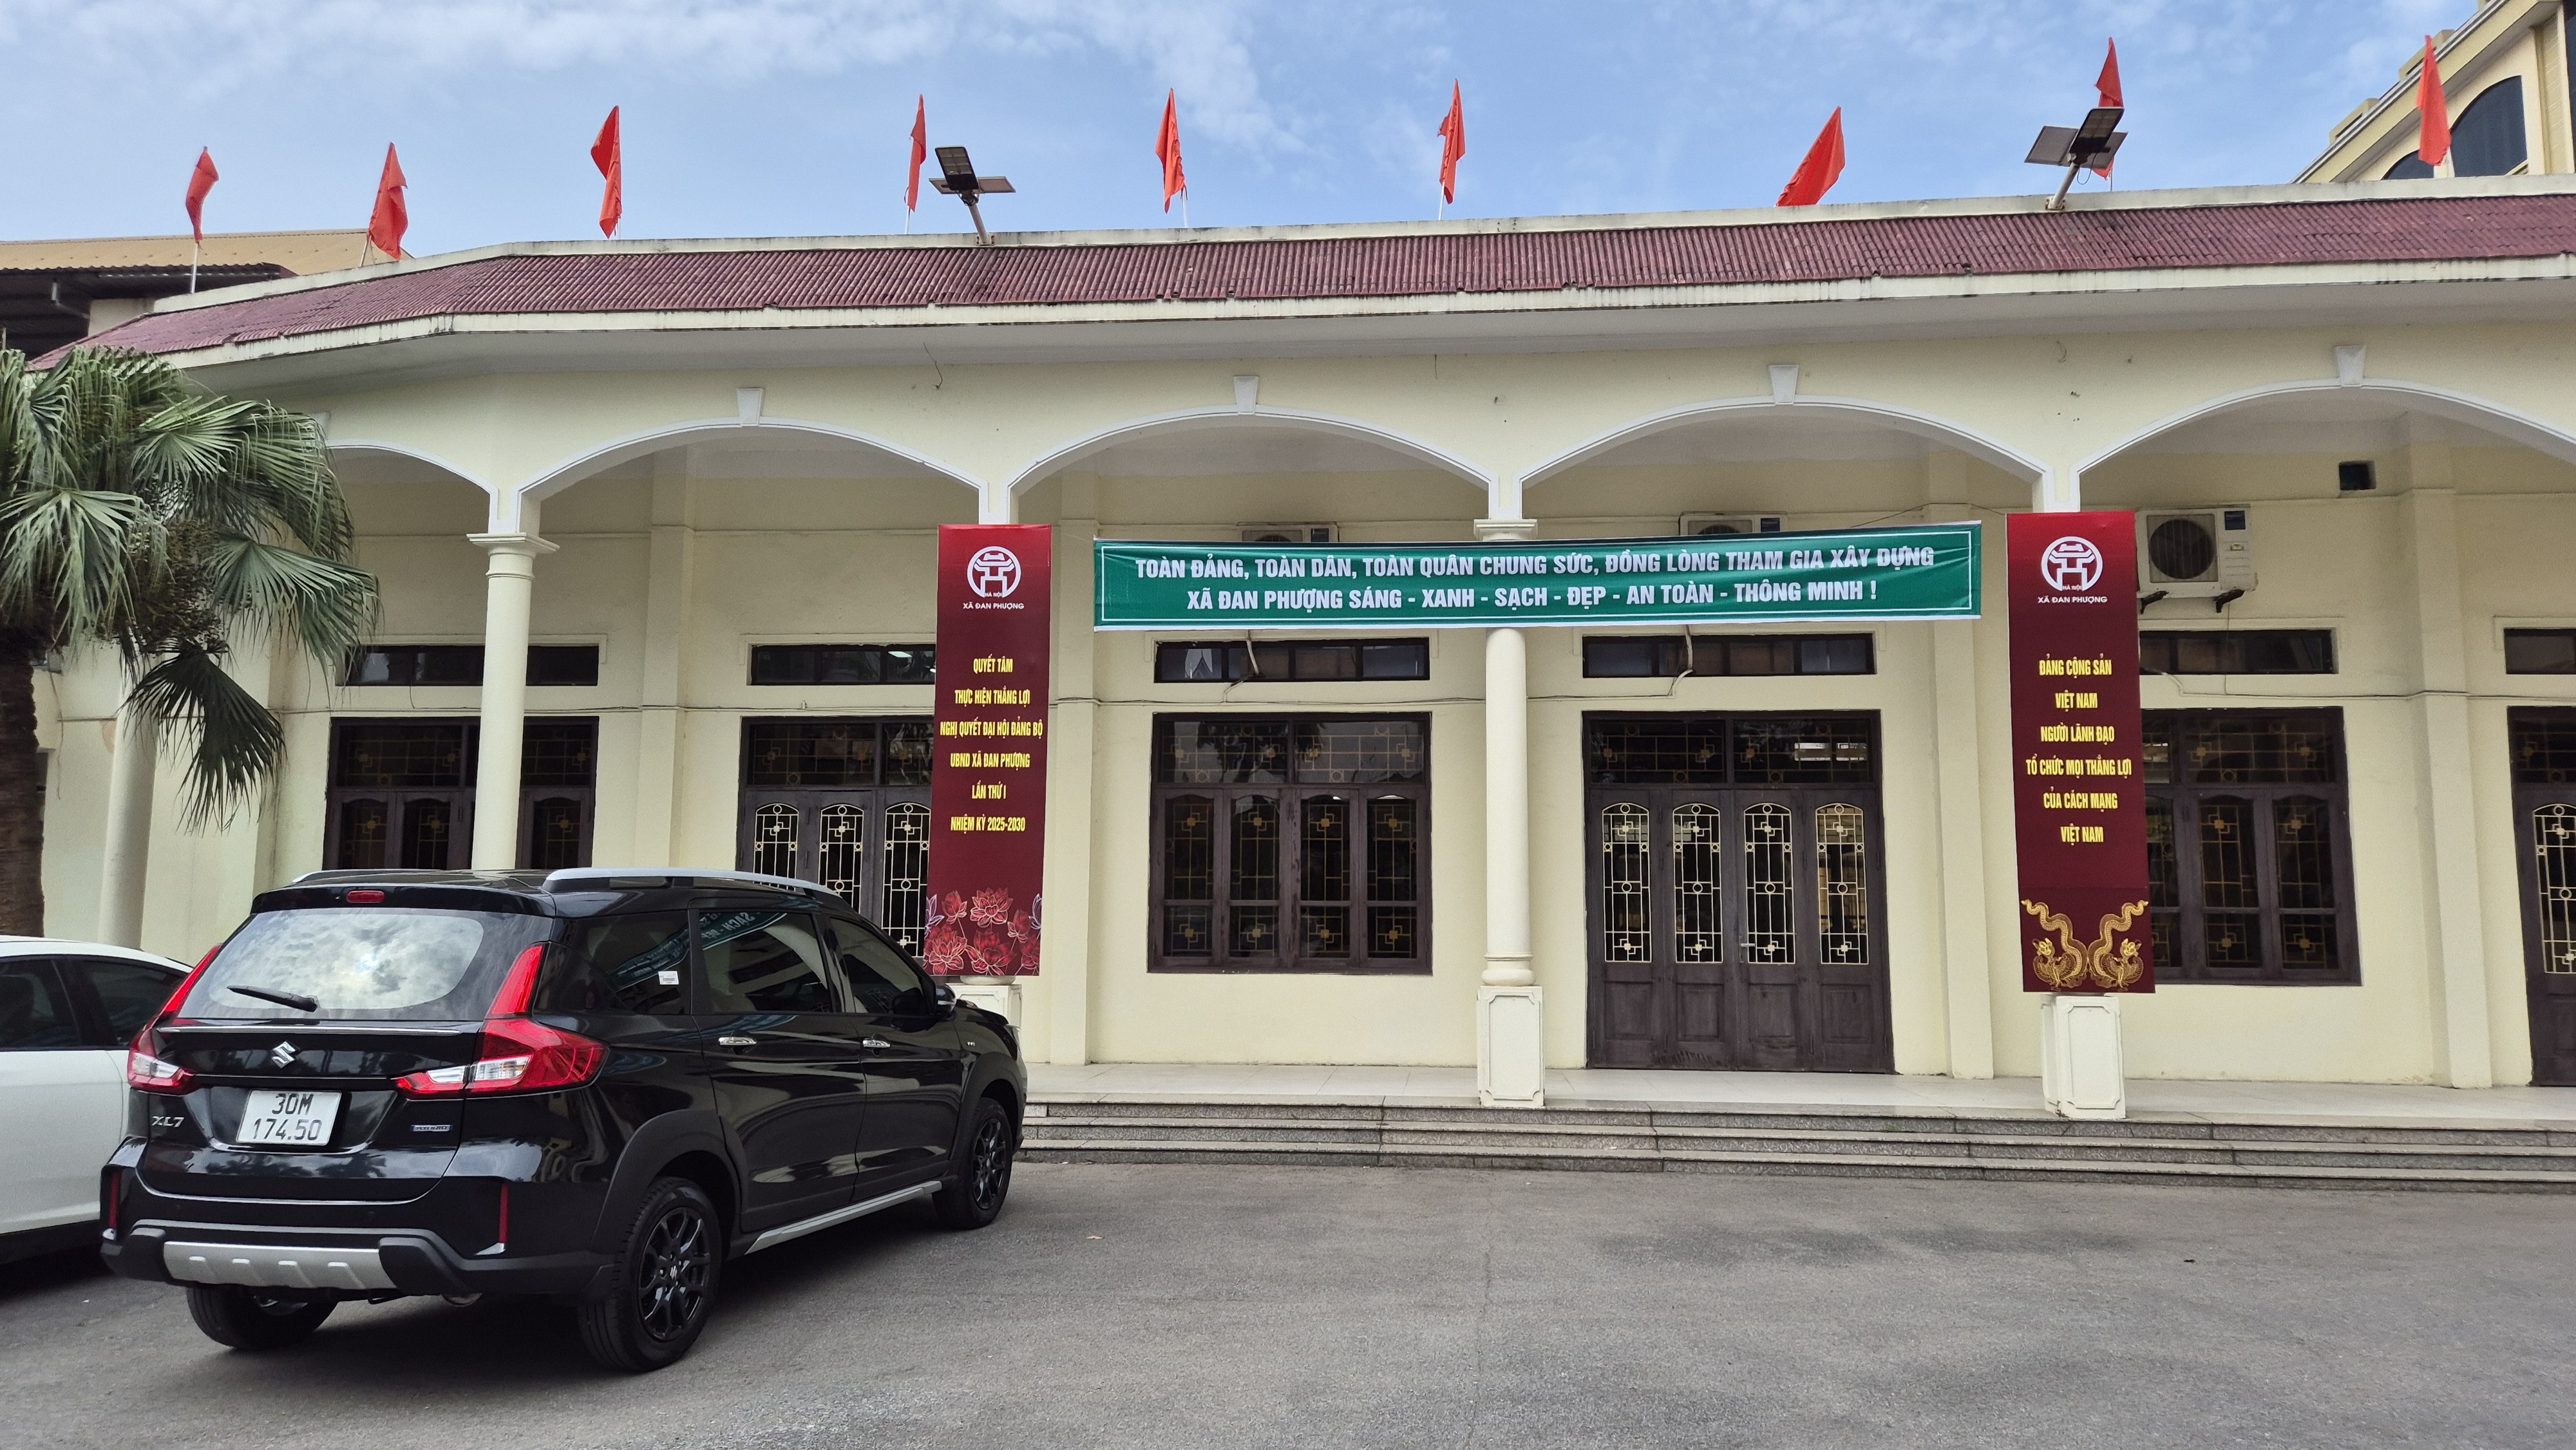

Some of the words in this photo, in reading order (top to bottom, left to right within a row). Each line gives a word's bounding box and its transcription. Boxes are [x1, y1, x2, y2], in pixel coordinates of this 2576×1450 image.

[1136, 556, 1185, 578] TOÀN
[1191, 553, 1249, 579] ĐẢNG,
[1255, 555, 1305, 578] TOÀN
[1311, 555, 1356, 579] DÂN,
[1363, 555, 1413, 576] TOÀN
[1420, 554, 1473, 578] QUÂN
[1480, 556, 1546, 574] CHUNG
[1554, 552, 1599, 575] SỨC,
[1605, 549, 1660, 573] ĐỒNG
[1667, 549, 1719, 571] LÒNG
[1726, 551, 1783, 570] THAM
[1790, 550, 1824, 569] GIA
[1831, 545, 1871, 568] XÂY
[1877, 545, 1934, 570] DỰNG
[993, 602, 1025, 610] PHƯỢNG
[1188, 587, 1213, 609] XÃ
[1218, 590, 1258, 609] ĐAN
[1265, 588, 1343, 612] PHƯỢNG
[1349, 587, 1401, 608] SÁNG
[1422, 589, 1474, 608] XANH
[1495, 587, 1547, 610] SẠCH
[1567, 587, 1606, 609] ĐẸP
[1627, 586, 1654, 605] AN
[1661, 581, 1714, 604] TOÀN
[1734, 579, 1801, 602] THÔNG
[1808, 581, 1863, 601] MINH
[1871, 580, 1877, 599] !
[2038, 595, 2050, 603] XÃ
[2072, 596, 2108, 604] PHƯỢNG
[973, 654, 996, 674] QUYẾT
[998, 655, 1013, 672] TÂM
[2039, 653, 2064, 675] ĐẢNG
[2066, 656, 2090, 679] CỘNG
[2093, 653, 2112, 675] SẢN
[954, 688, 973, 707] THỰC
[974, 687, 991, 707] HIỆN
[993, 685, 1017, 704] THẮNG
[1019, 689, 1030, 708] LỢI
[2055, 690, 2074, 711] VIỆT
[2076, 693, 2098, 708] NAM
[940, 722, 958, 739] NGHỊ
[959, 717, 981, 737] QUYẾT
[983, 722, 995, 739] ĐẠI
[997, 719, 1009, 739] HỘI
[1011, 716, 1031, 736] ĐẢNG
[1033, 719, 1043, 739] BỘ
[2040, 722, 2069, 742] NGƯỜI
[2070, 723, 2094, 742] LÃNH
[2096, 726, 2115, 745] ĐẠO
[951, 753, 970, 767] UBND
[972, 751, 981, 767] XÃ
[983, 753, 999, 767] ĐAN
[1000, 751, 1030, 771] PHƯỢNG
[2026, 753, 2038, 775] TỔ
[2040, 755, 2064, 775] CHỨC
[2066, 759, 2084, 778] MỌI
[2085, 754, 2116, 775] THẮNG
[2117, 758, 2132, 778] LỢI
[988, 781, 1003, 799] THỨ
[1003, 785, 1007, 799] I
[2043, 786, 2062, 809] CỦA
[2064, 789, 2088, 809] CÁCH
[2090, 793, 2118, 813] MẠNG
[951, 813, 974, 834] NHIỆM
[976, 813, 986, 831] KỲ
[987, 816, 1026, 831] 2025-2030
[2061, 823, 2079, 846] VIỆT
[2082, 827, 2104, 842] NAM
[272, 1093, 314, 1115] 30M
[151, 1116, 185, 1127] XL7
[254, 1118, 323, 1141] 174.50
